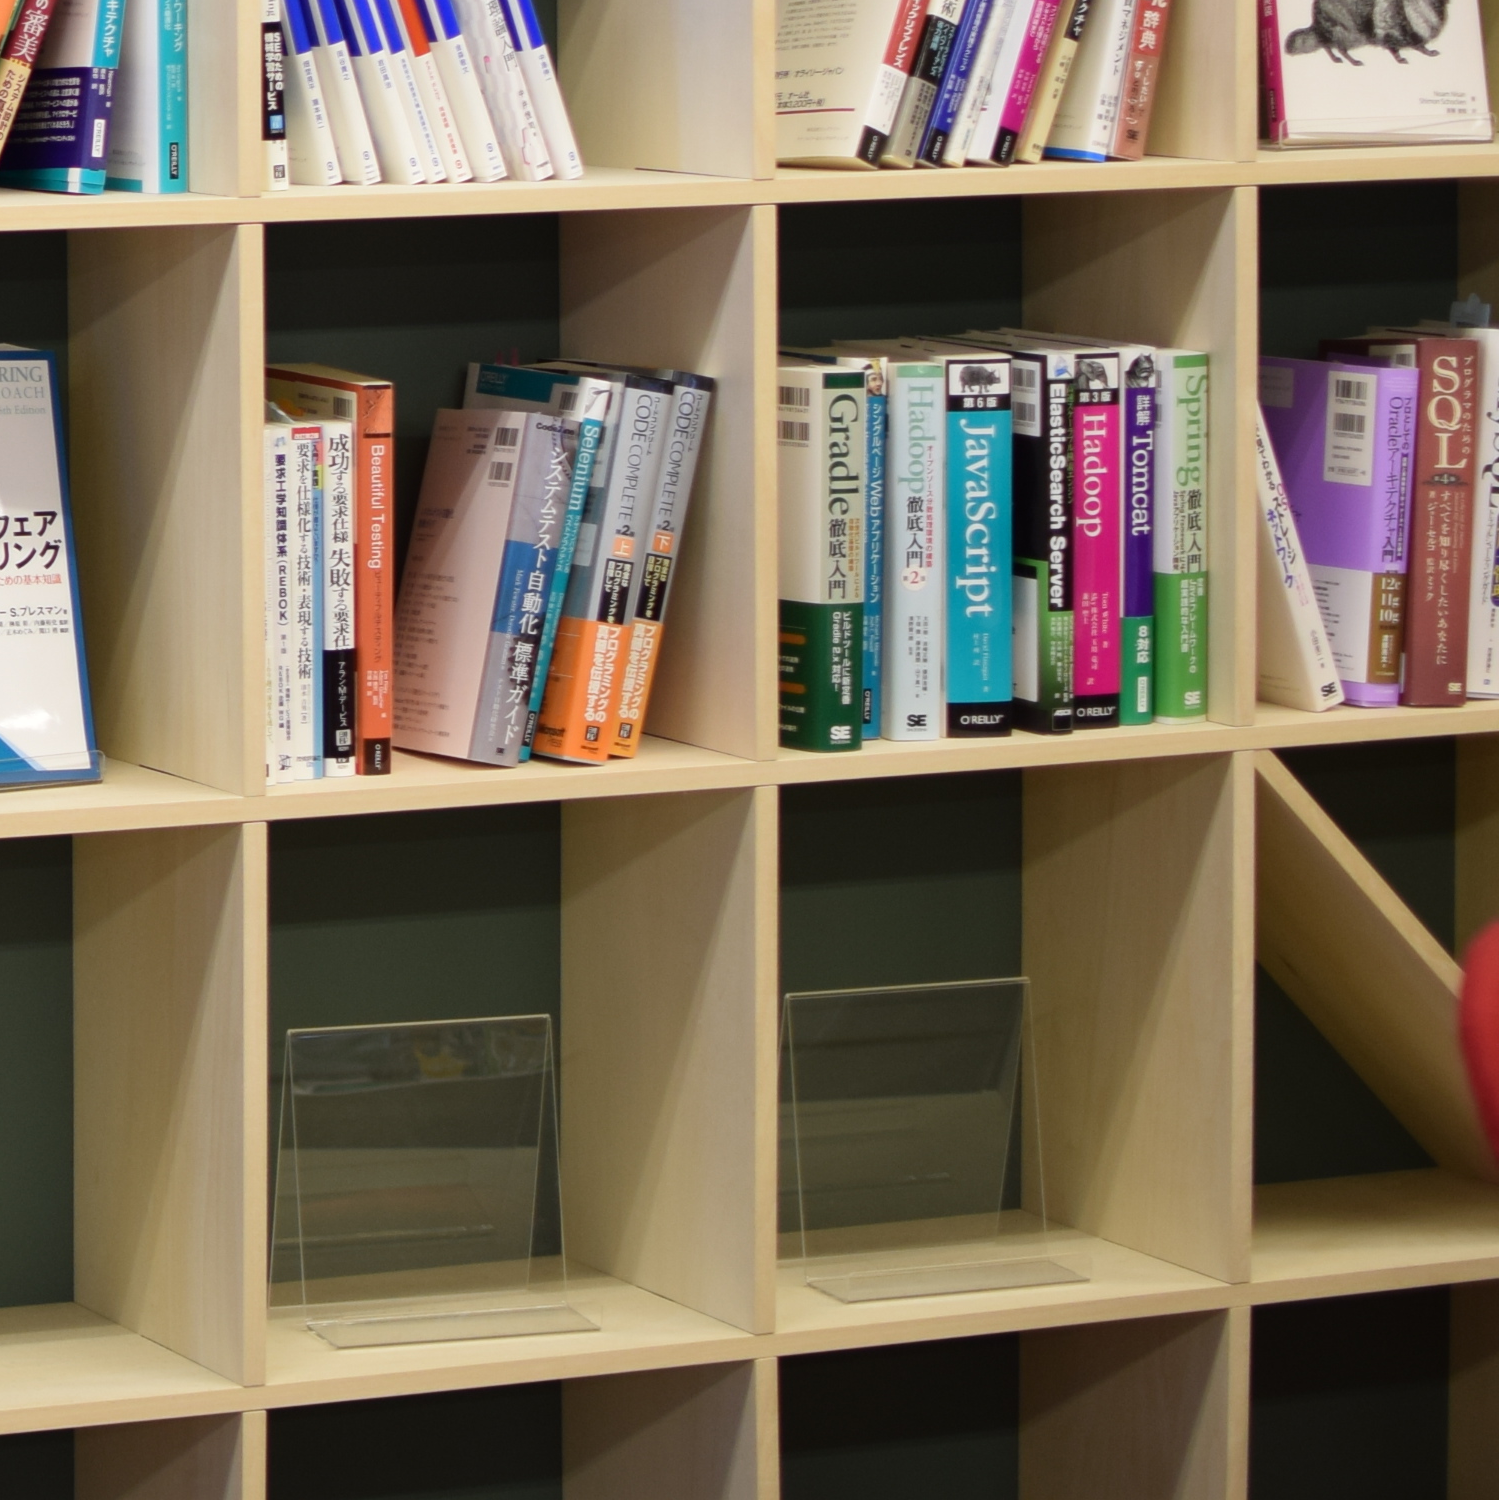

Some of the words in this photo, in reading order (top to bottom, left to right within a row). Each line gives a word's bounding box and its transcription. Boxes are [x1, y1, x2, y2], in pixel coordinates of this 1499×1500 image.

[274, 32, 284, 91] SEのための
[15, 405, 46, 417] Edition
[536, 422, 575, 436] CodeZine
[630, 394, 654, 443] CODE
[674, 391, 697, 439] CODE
[962, 396, 997, 409] 第6版
[1079, 392, 1112, 402] 第3版
[1401, 397, 1412, 451] プロとしての
[1427, 356, 1467, 469] SQL
[1461, 355, 1474, 455] プログラマのための
[371, 445, 385, 509] Beautiful
[568, 424, 601, 511] Selenium
[870, 403, 882, 478] シングルページ
[1050, 383, 1067, 530] ElasticSearch
[1076, 412, 1108, 537] Hadoop
[327, 433, 351, 543] 成功する要求仕様
[617, 443, 644, 522] COMPLETE
[659, 440, 686, 518] COMPLETE
[870, 480, 883, 518] Web
[925, 445, 934, 567] オープンソース分散処理環境の構築
[1131, 430, 1153, 537] Tomcat
[1381, 396, 1403, 562] Oracleアーキテクチャ入門
[275, 454, 289, 626] 要求工学知識体系(REBOK)
[368, 515, 385, 569] Testing
[518, 448, 569, 635] システムテスト自動化
[615, 541, 632, 557] 上
[657, 534, 671, 550] 下
[956, 419, 997, 617] JavaScript
[296, 442, 312, 680] 要求を仕様化する技術・表現する技術
[870, 520, 881, 603] アプリケーション
[1050, 536, 1066, 609] Server
[1381, 577, 1401, 590] 12c
[1436, 490, 1452, 666] すべてを知り尽くしたいあなたに
[832, 611, 841, 644] Gradle
[1189, 580, 1197, 674] Javaフレームワークの
[504, 641, 535, 746] 標準ガイド
[594, 627, 622, 723] プログラミングの
[629, 625, 657, 721] プログラミングの
[830, 726, 851, 740] SE
[907, 714, 927, 727] SE
[960, 715, 1004, 725] O'REILLY
[1076, 706, 1116, 717] O'REILLY
